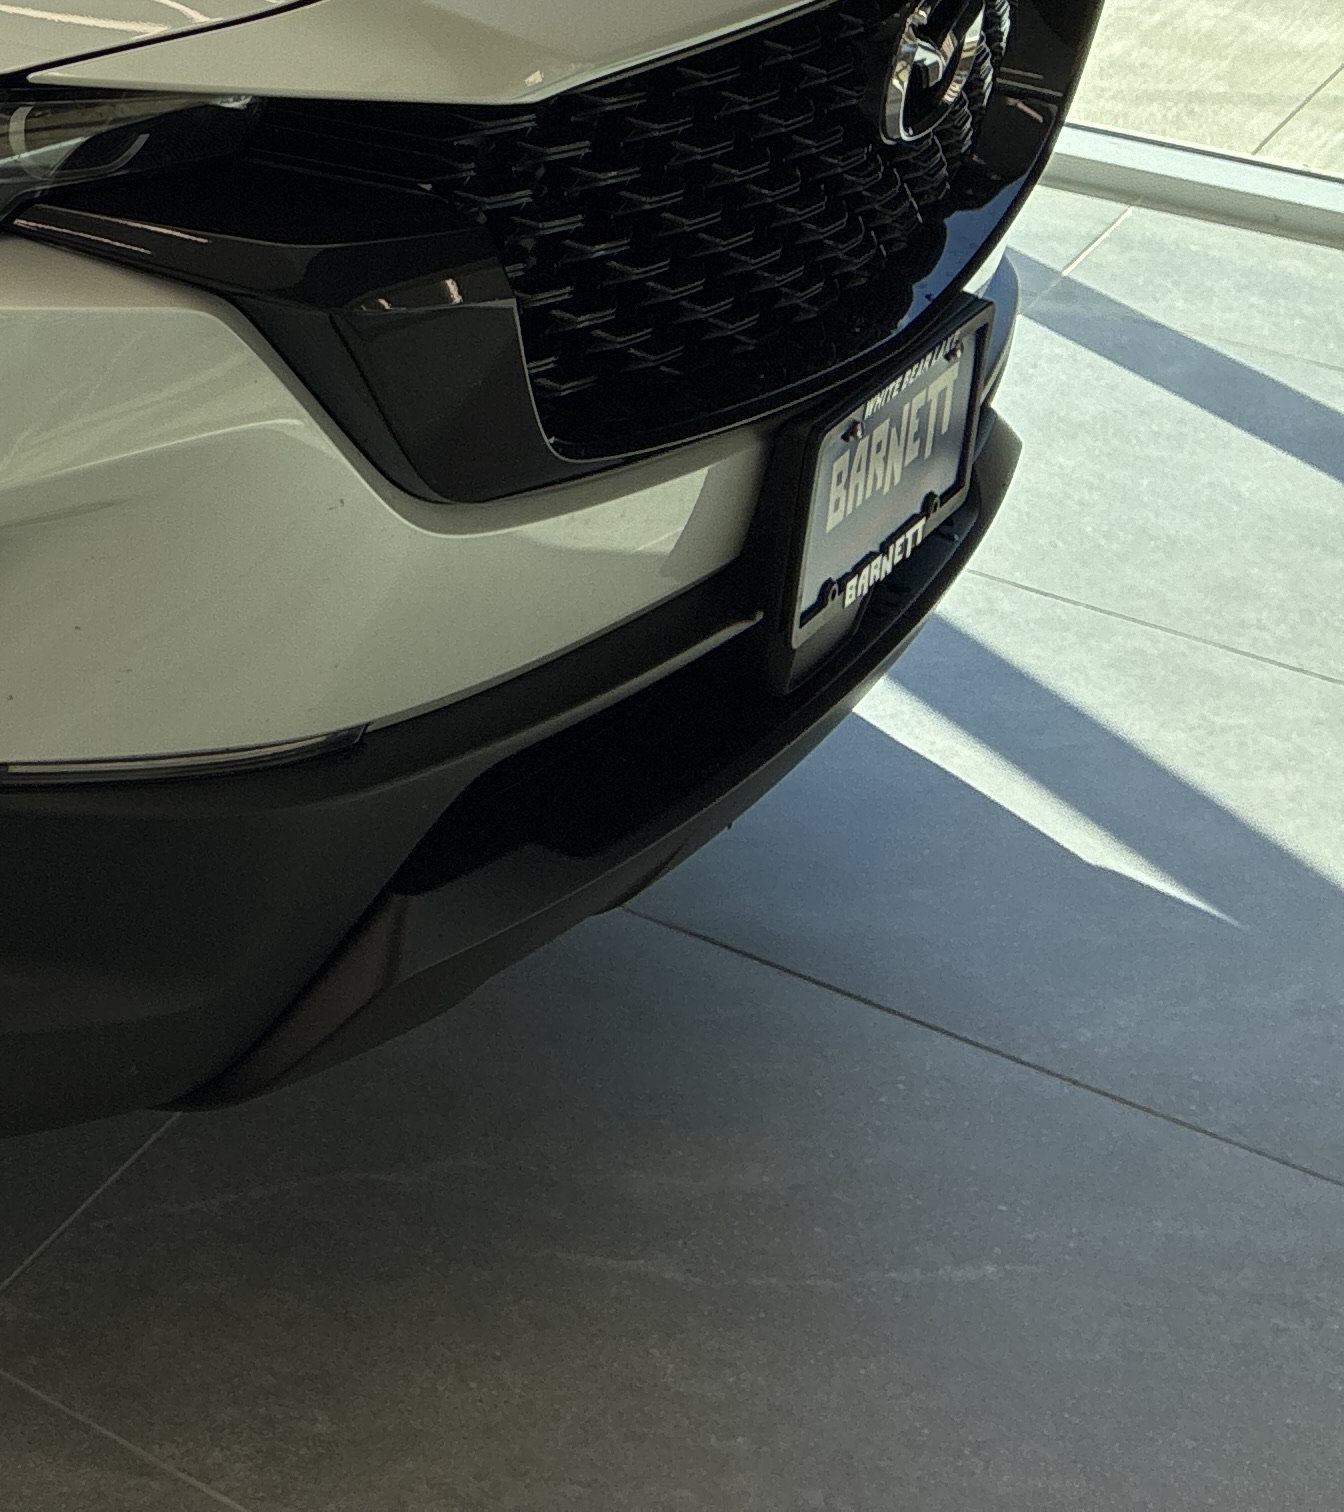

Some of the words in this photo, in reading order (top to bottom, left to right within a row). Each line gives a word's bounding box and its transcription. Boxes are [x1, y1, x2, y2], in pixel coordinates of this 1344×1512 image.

[863, 374, 904, 421] WHITE
[901, 350, 933, 392] BEAR
[826, 361, 960, 533] BARNETT
[844, 515, 927, 609] BARNETT
